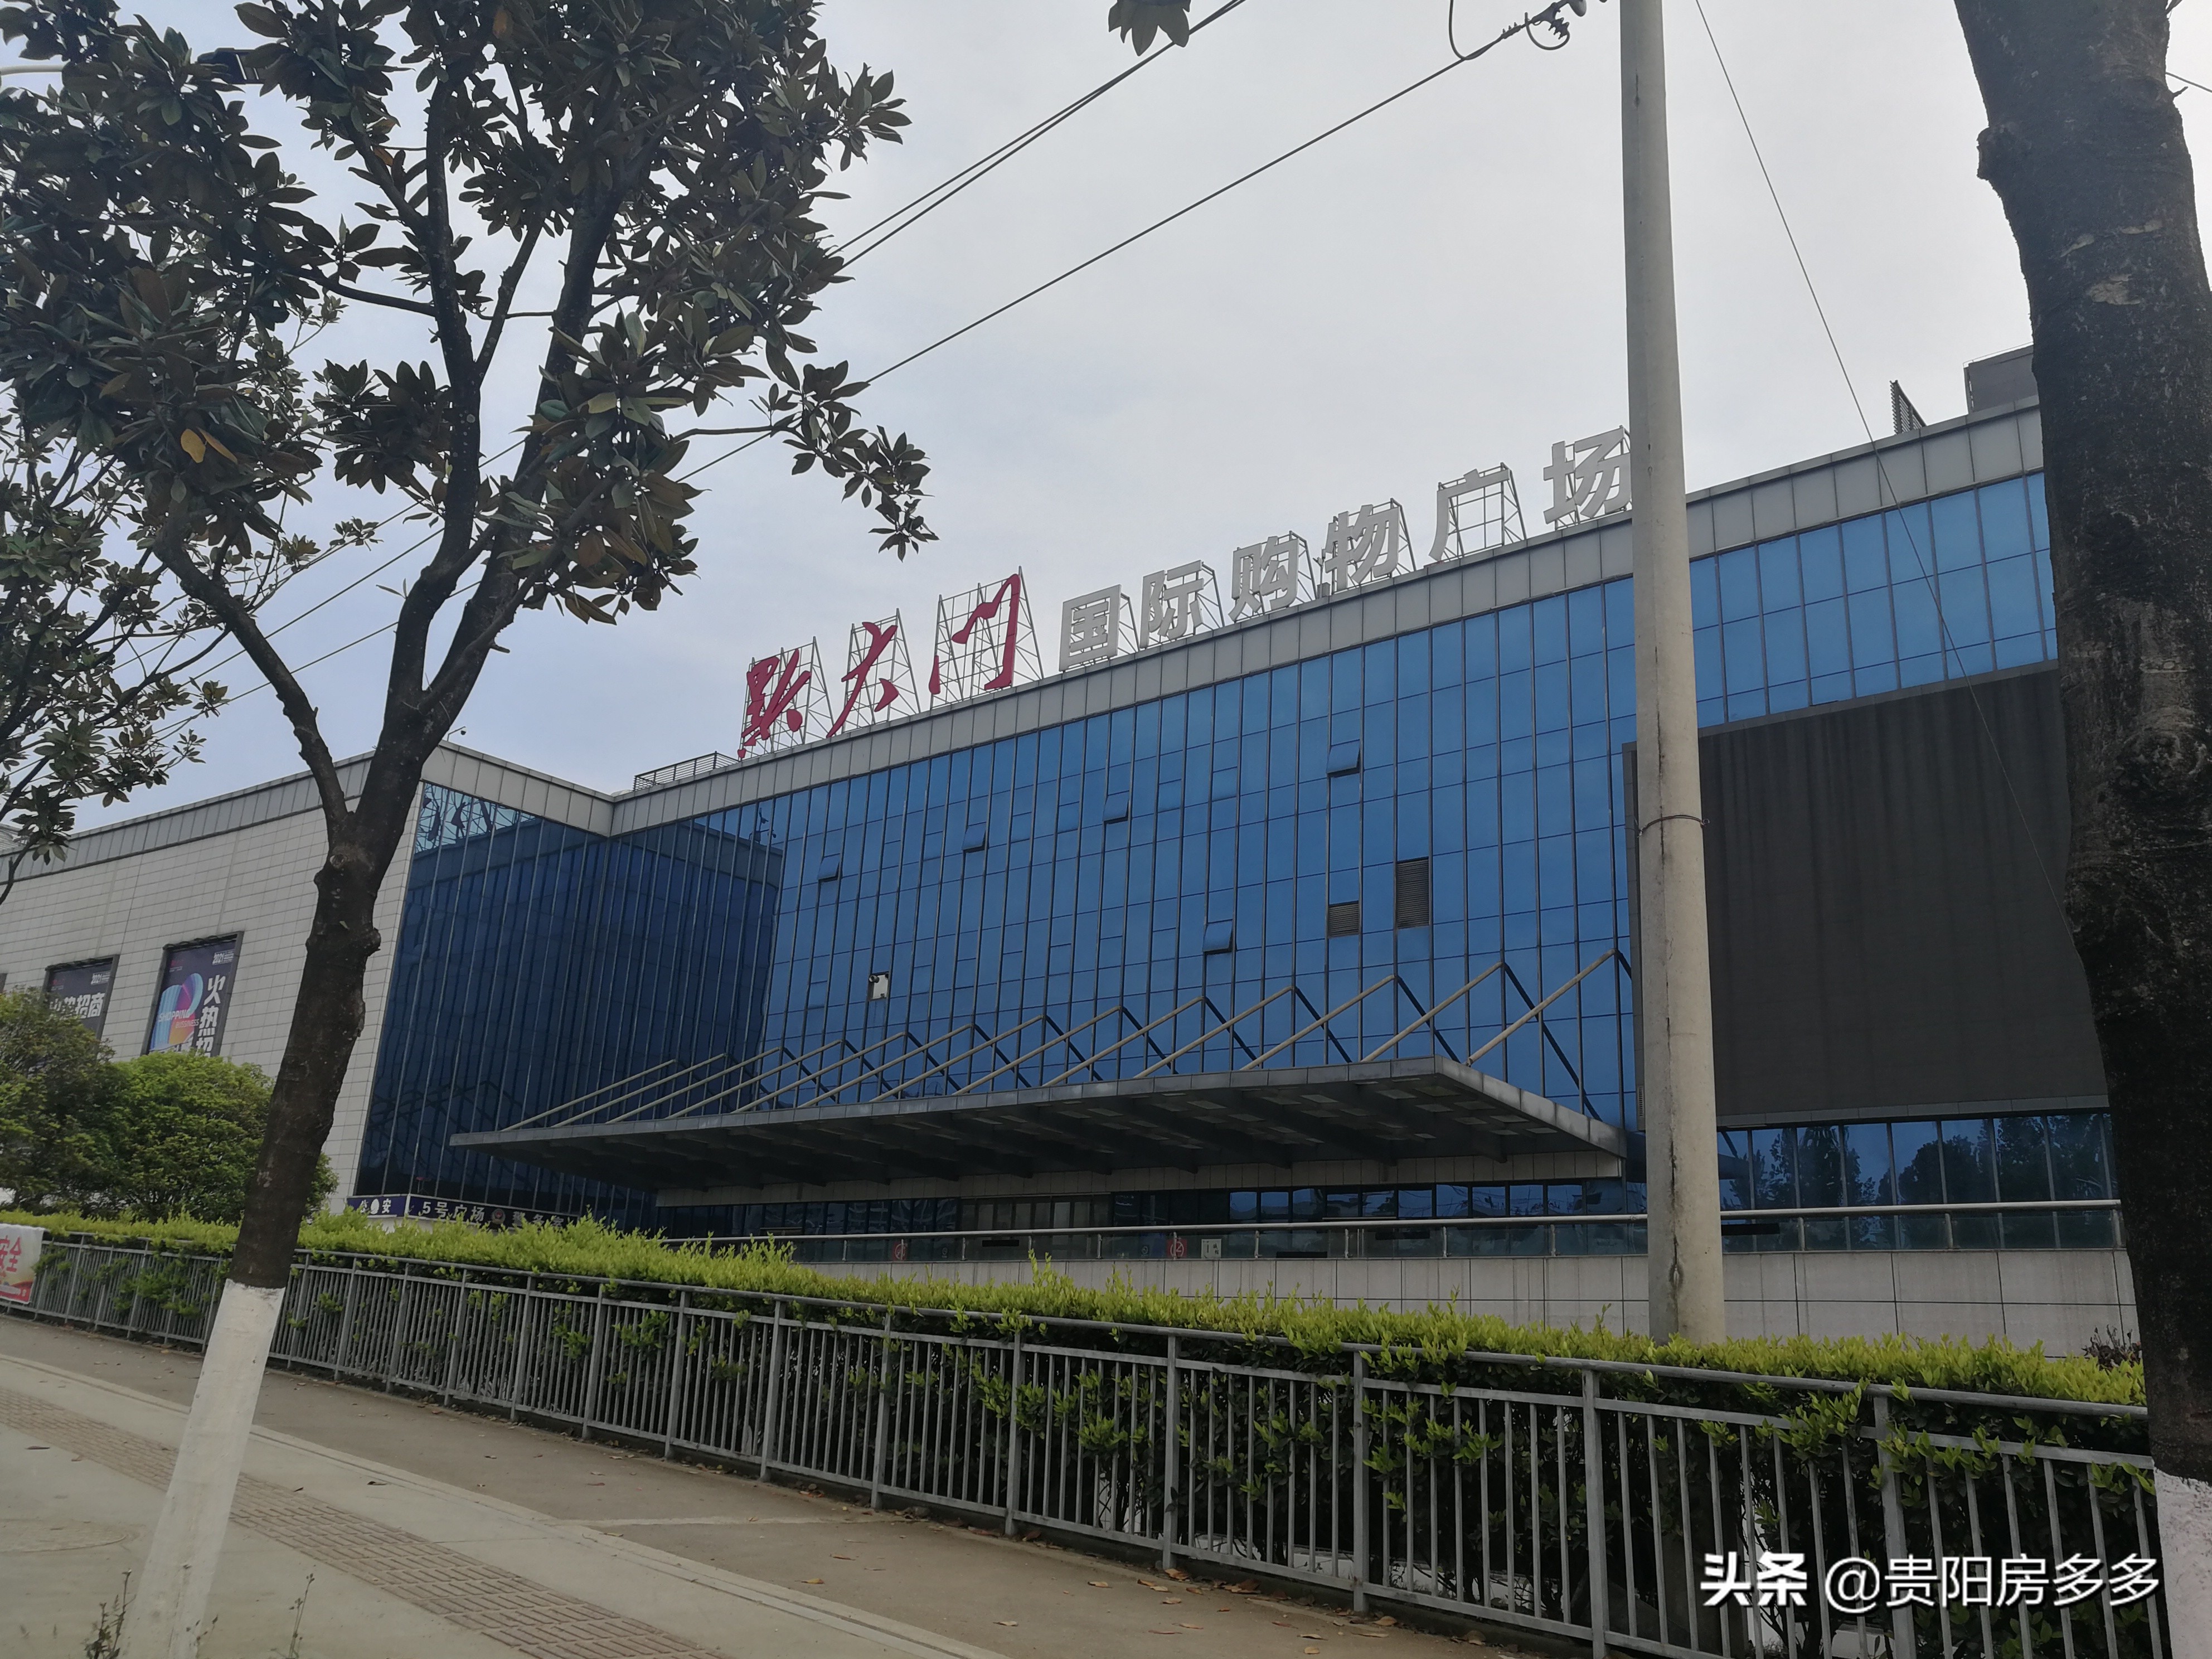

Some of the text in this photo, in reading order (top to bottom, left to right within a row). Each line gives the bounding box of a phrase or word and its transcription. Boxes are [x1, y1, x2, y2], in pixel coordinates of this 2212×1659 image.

[1058, 426, 1632, 672] 国际购物广场
[422, 1201, 486, 1222] 5号广场
